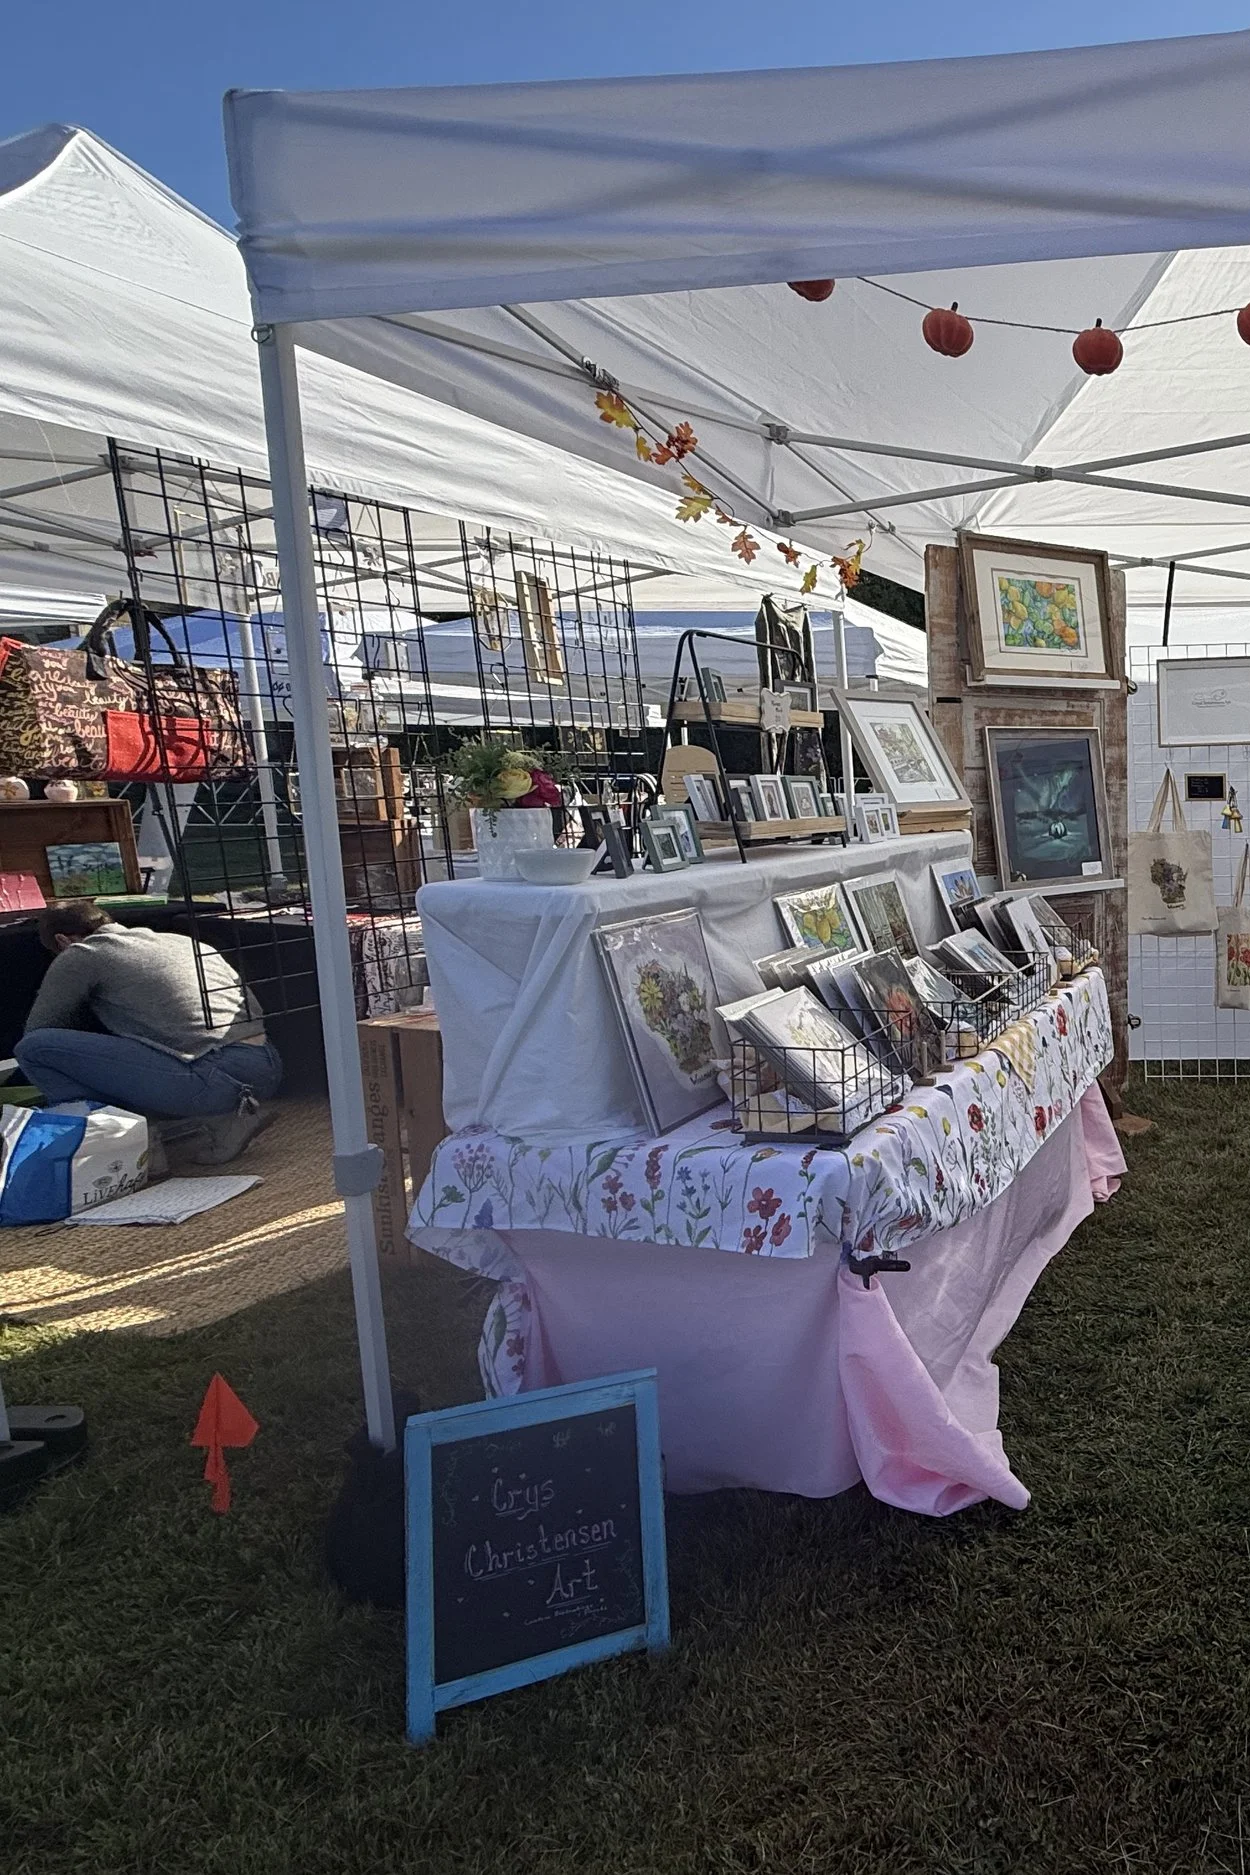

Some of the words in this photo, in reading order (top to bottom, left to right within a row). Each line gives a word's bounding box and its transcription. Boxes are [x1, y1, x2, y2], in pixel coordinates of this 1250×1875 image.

[54, 702, 98, 722] beauty
[84, 689, 127, 712] beauty
[492, 1478, 556, 1520] Crys
[465, 1519, 617, 1577] Christensen
[546, 1559, 599, 1604] Art
